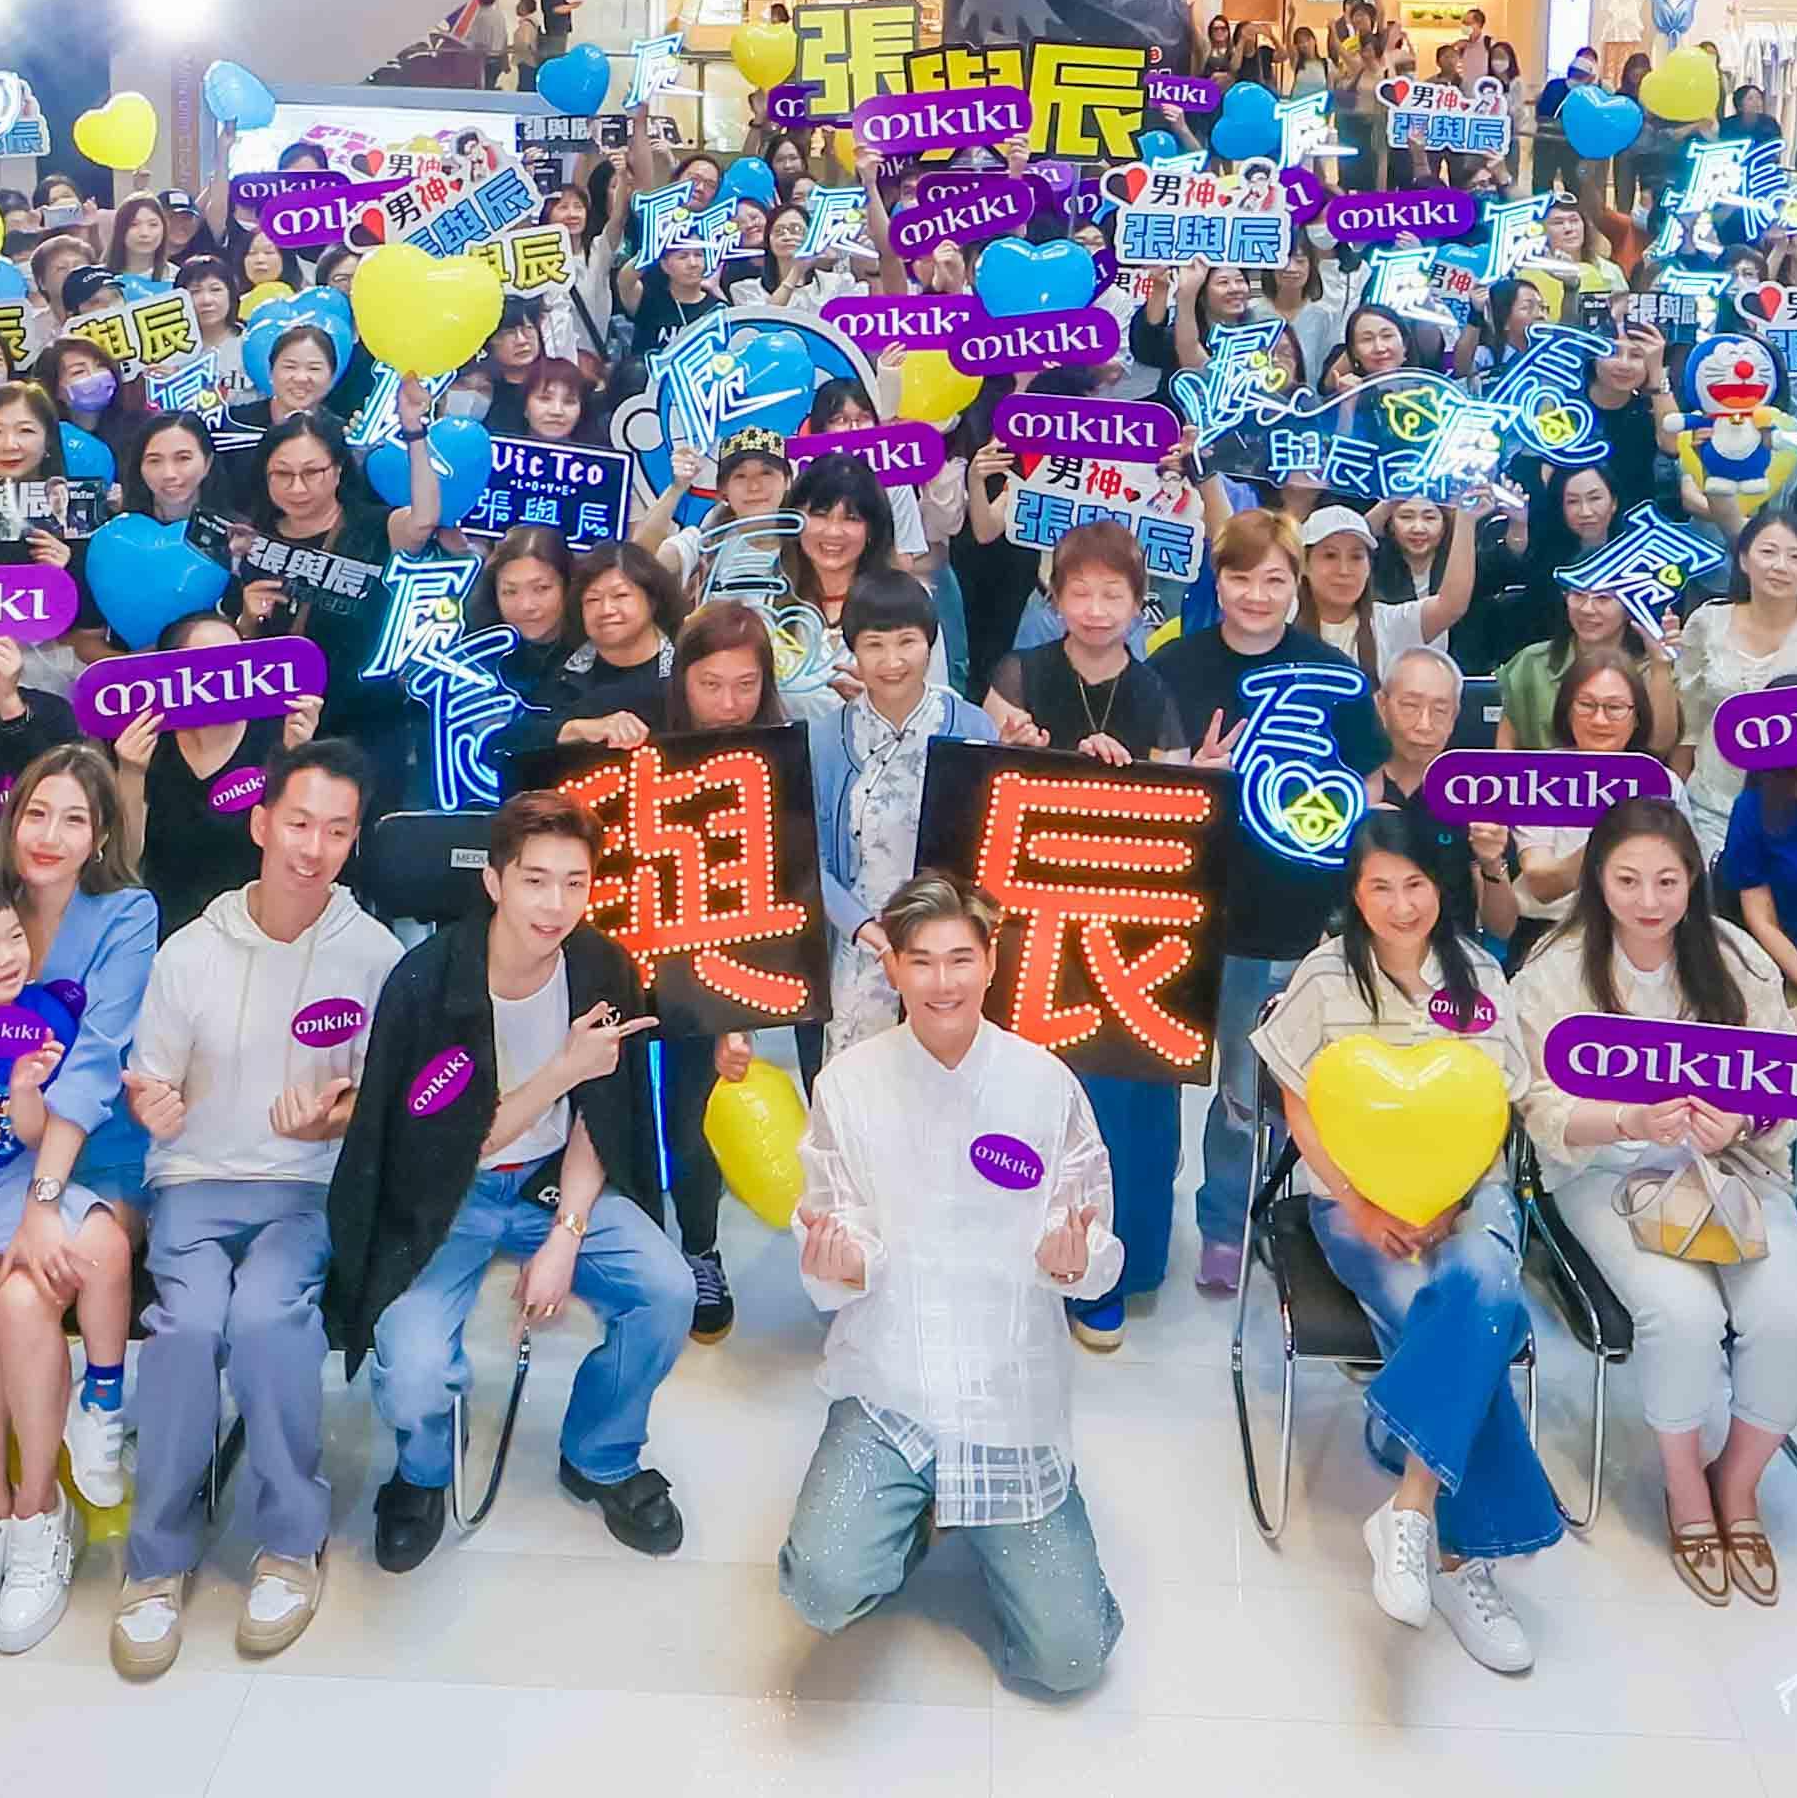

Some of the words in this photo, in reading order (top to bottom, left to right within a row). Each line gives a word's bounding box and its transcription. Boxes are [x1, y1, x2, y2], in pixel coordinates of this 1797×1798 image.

[1147, 79, 1207, 104] ikiki
[1412, 84, 1458, 110] 男神
[862, 100, 1022, 144] mikiki
[1393, 112, 1504, 151] 張與辰
[386, 177, 448, 230] 男神
[1150, 172, 1217, 206] 男神
[272, 196, 361, 237] mik
[900, 192, 1020, 244] mikiki
[1338, 201, 1459, 237] mikiki
[1124, 213, 1281, 263] 張與辰
[1113, 269, 1154, 300] 男神
[1431, 262, 1472, 294] 男神
[960, 321, 1103, 364] mikiki
[1007, 407, 1159, 450] mikiki
[491, 447, 545, 476] Vic
[553, 452, 604, 485] Teo
[791, 438, 927, 481] miki
[1047, 457, 1123, 499] 男神
[248, 535, 383, 597] 張與辰
[94, 657, 300, 720] mikiki
[1445, 766, 1640, 806] mikiki
[975, 772, 1210, 1068] 辰
[294, 1012, 362, 1035] mikiki
[1430, 999, 1492, 1021] miki
[413, 1050, 470, 1112] mikiki
[974, 1145, 1040, 1181] mikiki
